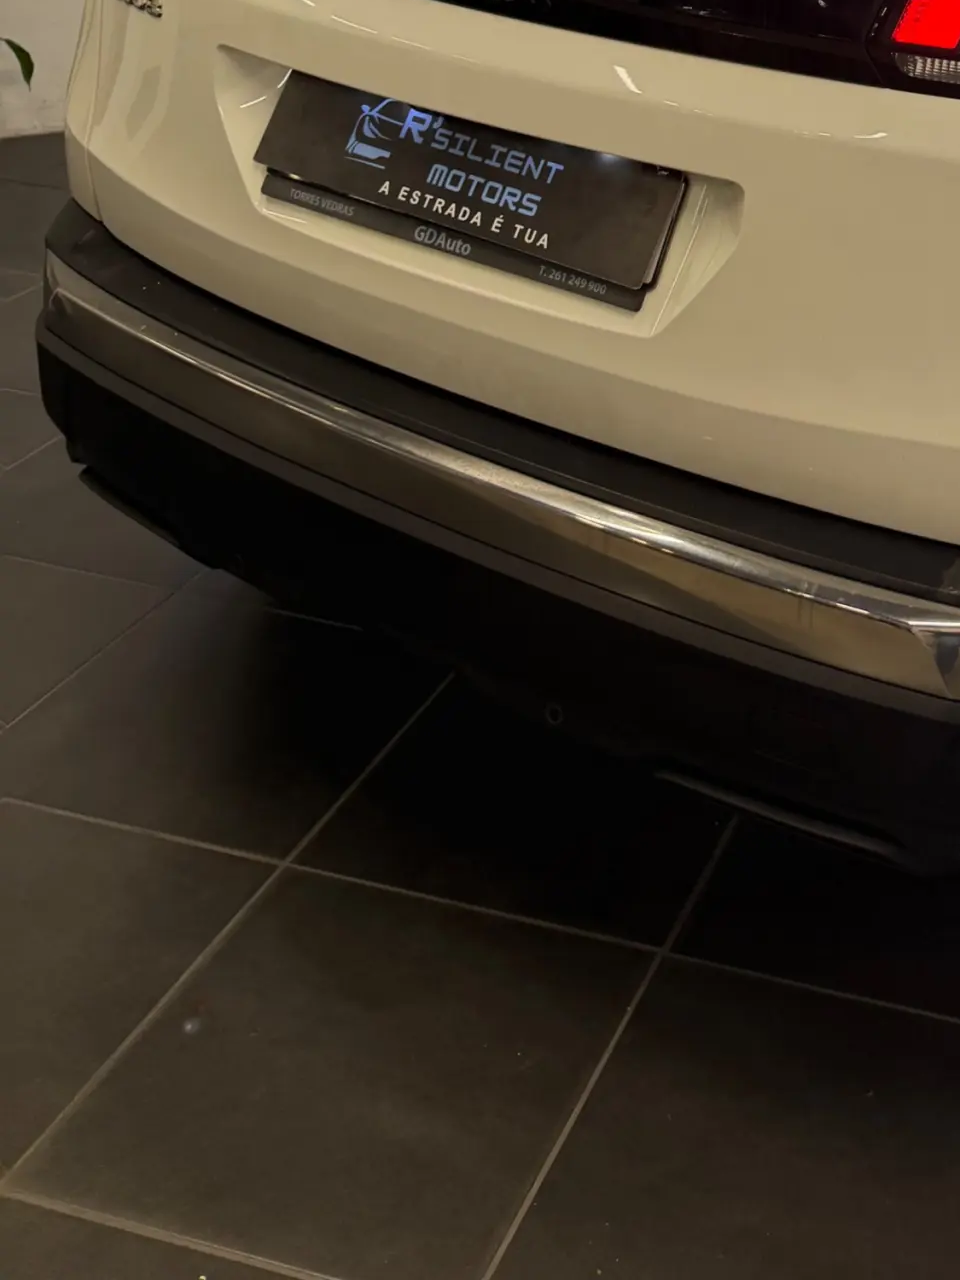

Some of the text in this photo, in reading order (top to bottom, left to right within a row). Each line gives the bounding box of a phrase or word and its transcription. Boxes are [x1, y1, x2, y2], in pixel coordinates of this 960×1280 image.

[289, 187, 356, 217] TORRES VEDRAS
[426, 163, 542, 217] MOTORS
[378, 180, 549, 250] A ESTRADA É TUA
[413, 224, 472, 256] GDAuto
[548, 269, 567, 283] 261
[568, 273, 588, 289] 249
